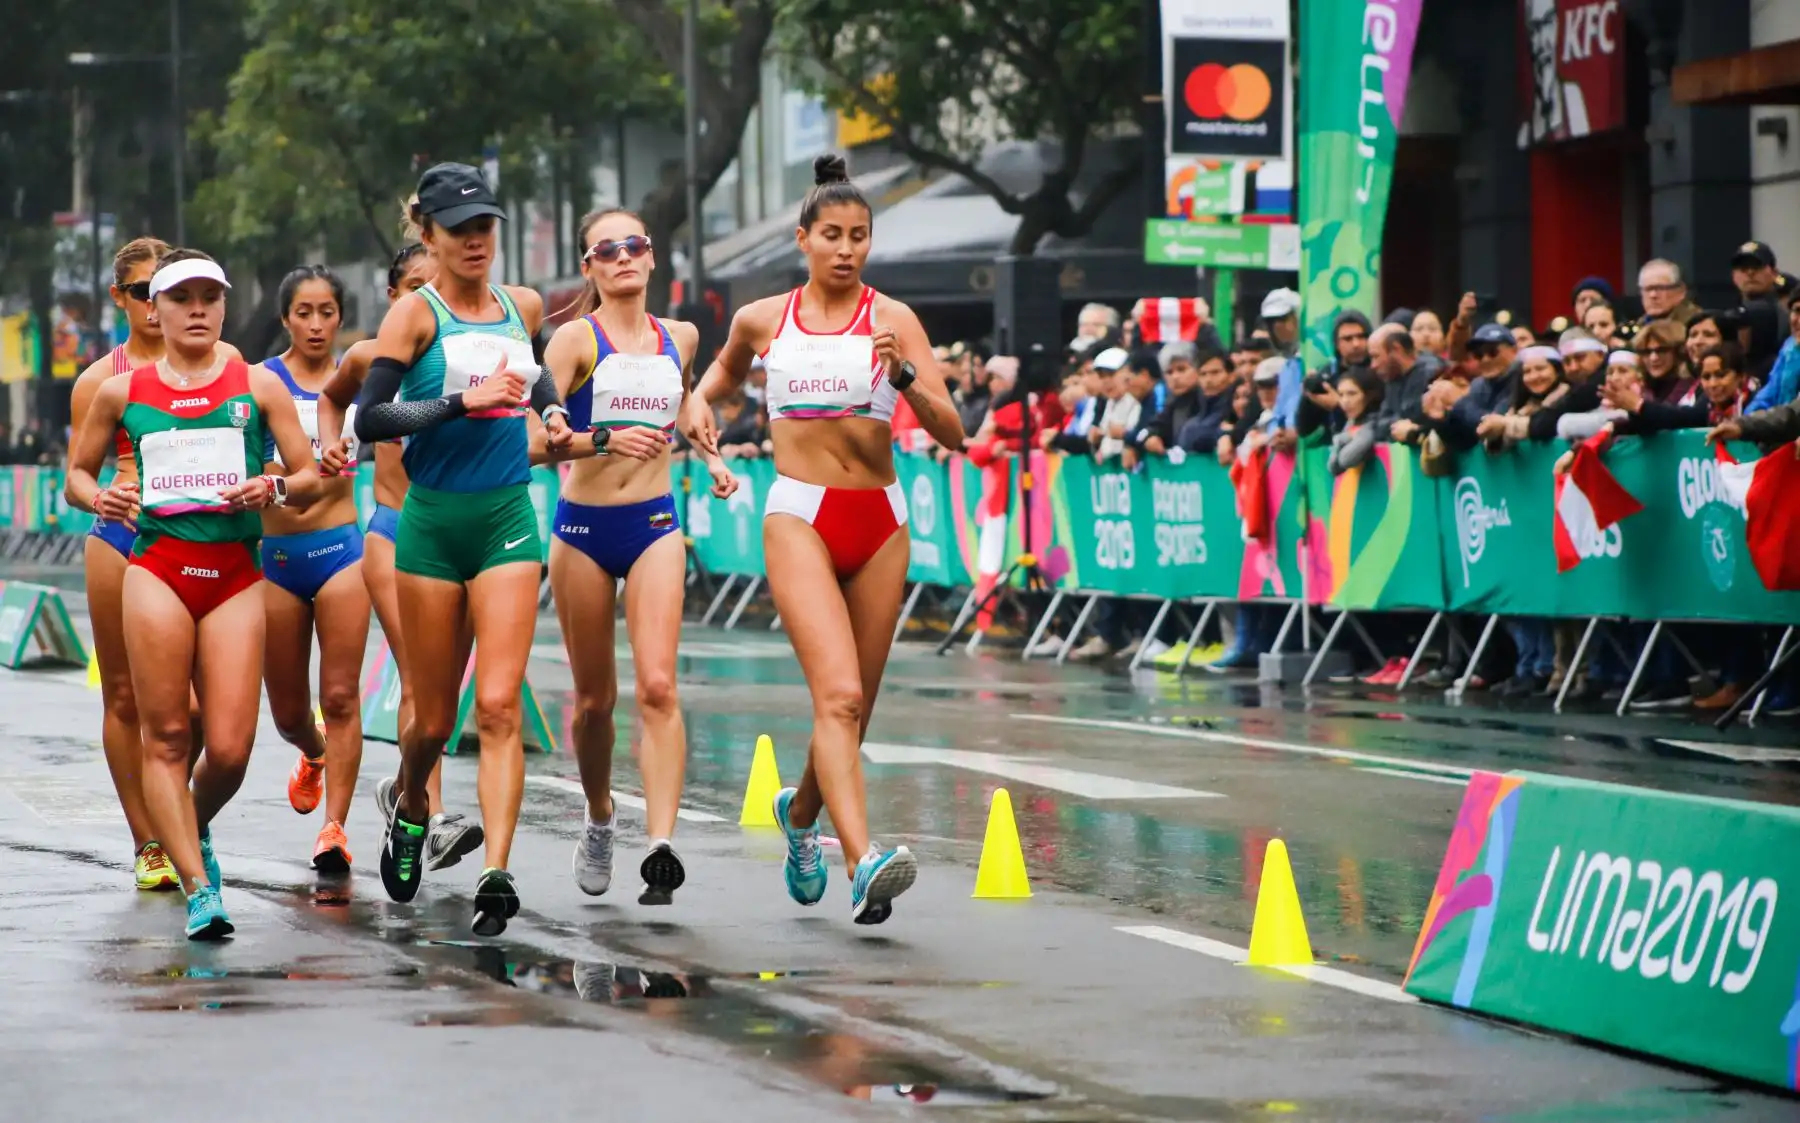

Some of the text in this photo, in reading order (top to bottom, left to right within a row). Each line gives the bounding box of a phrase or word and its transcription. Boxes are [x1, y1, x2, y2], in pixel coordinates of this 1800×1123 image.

[1562, 0, 1618, 63] KFC
[1185, 122, 1268, 136] mastercard
[788, 375, 849, 393] GARCÍA
[170, 397, 210, 409] Joma
[610, 396, 669, 411] ARENAS
[151, 472, 239, 490] GUERRERO
[560, 524, 589, 533] SAETA
[308, 543, 344, 558] ECUADOR
[1094, 519, 1135, 569] 2019
[181, 565, 220, 578] Joma
